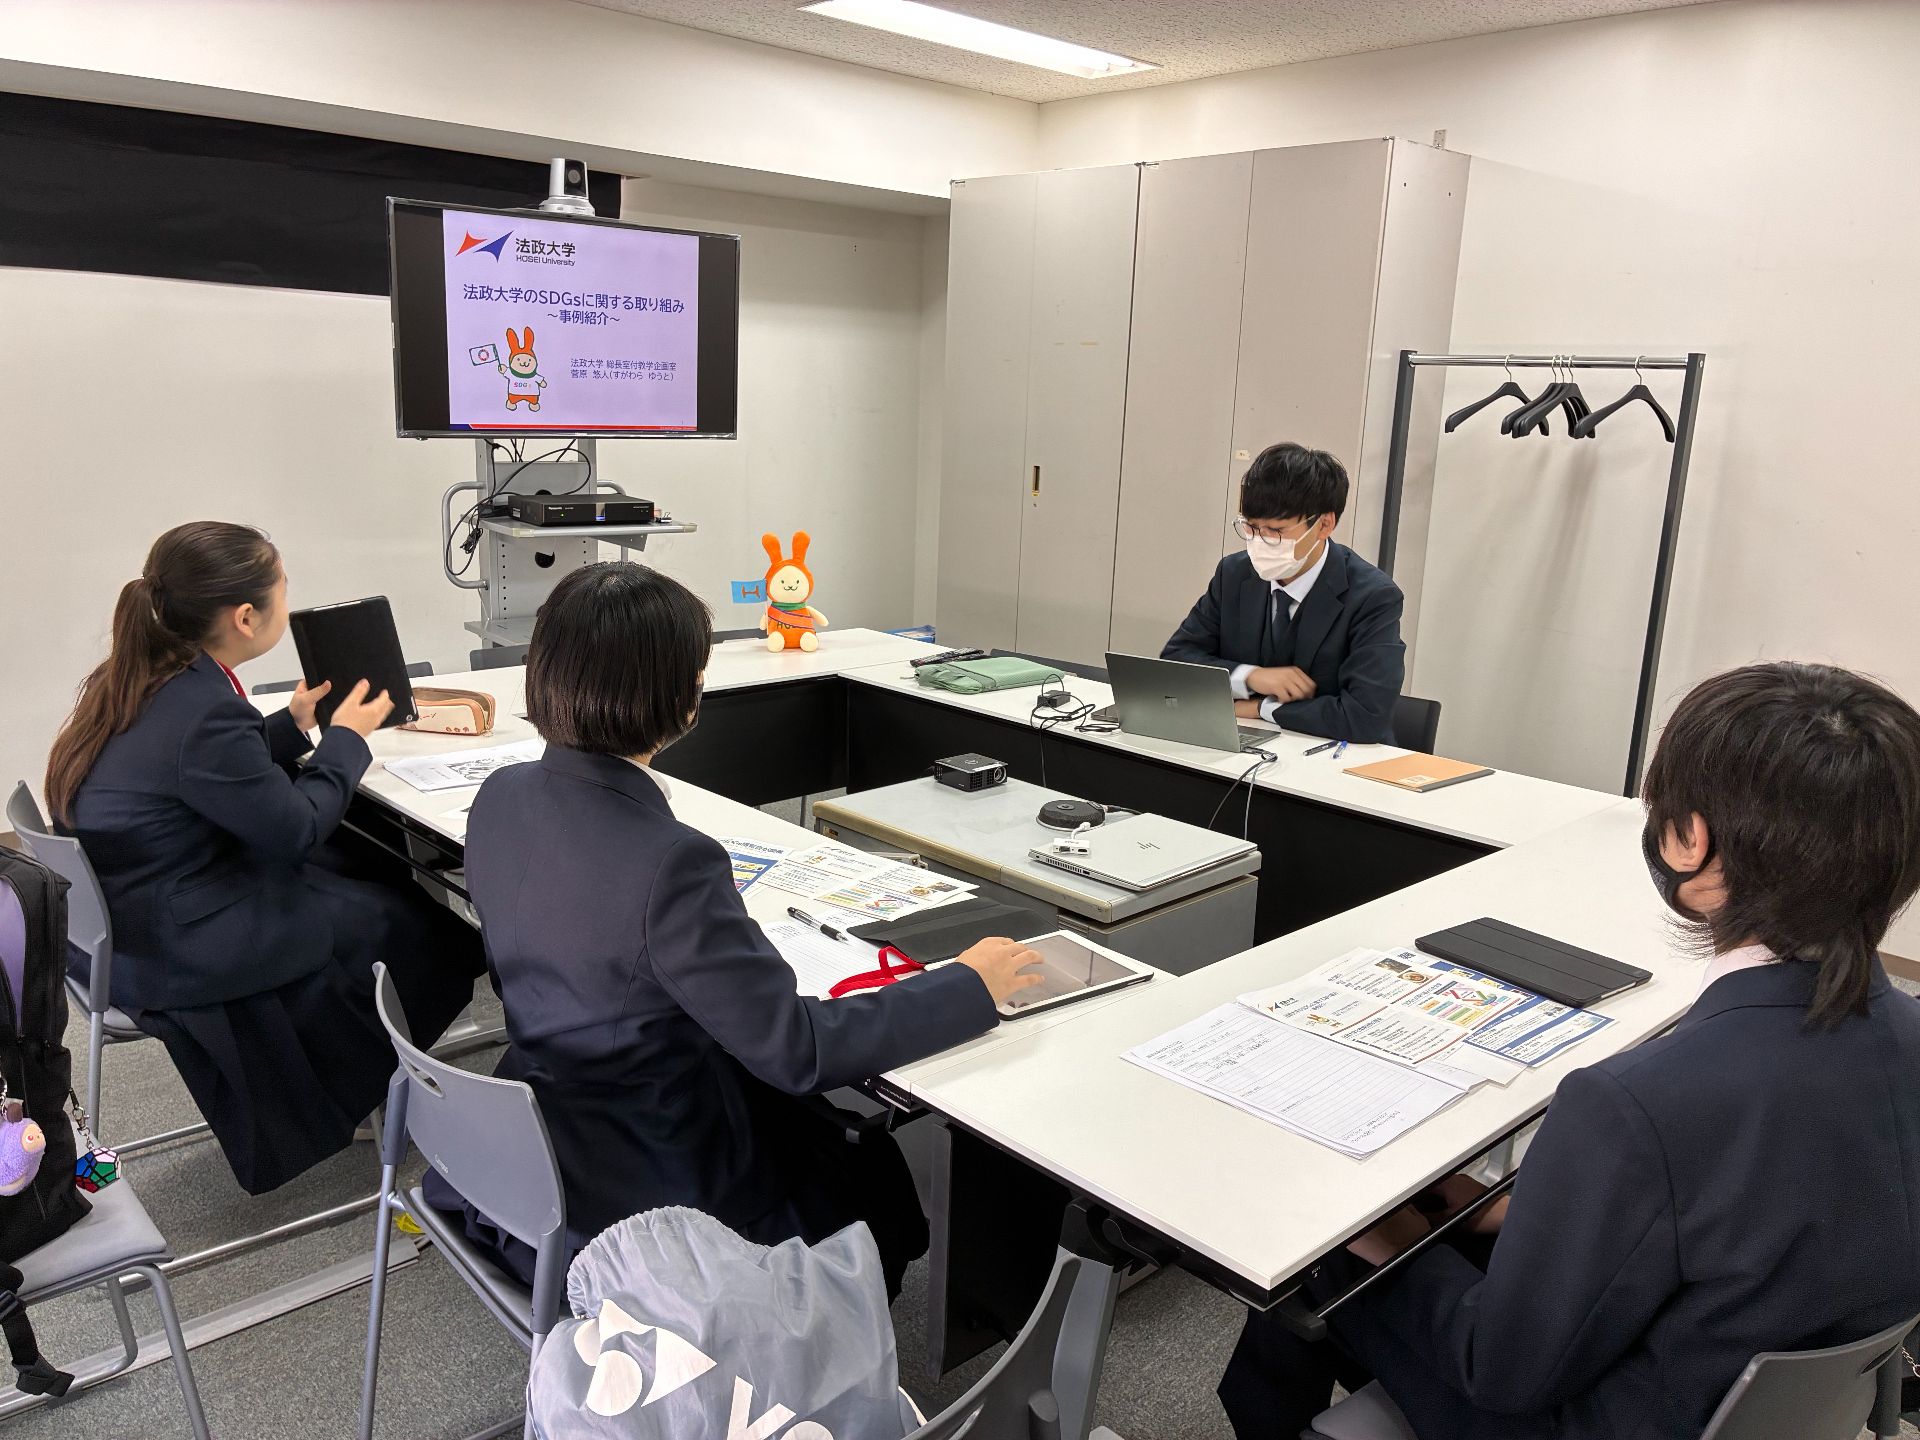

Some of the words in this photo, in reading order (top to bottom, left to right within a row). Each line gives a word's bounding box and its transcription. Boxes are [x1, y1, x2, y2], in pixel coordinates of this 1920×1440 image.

[515, 238, 576, 258] 法政大学
[516, 255, 541, 264] HOSEI
[541, 257, 576, 267] University
[463, 283, 685, 314] 法政大学のSDGsに関する取り組み
[570, 358, 604, 369] 法政大学
